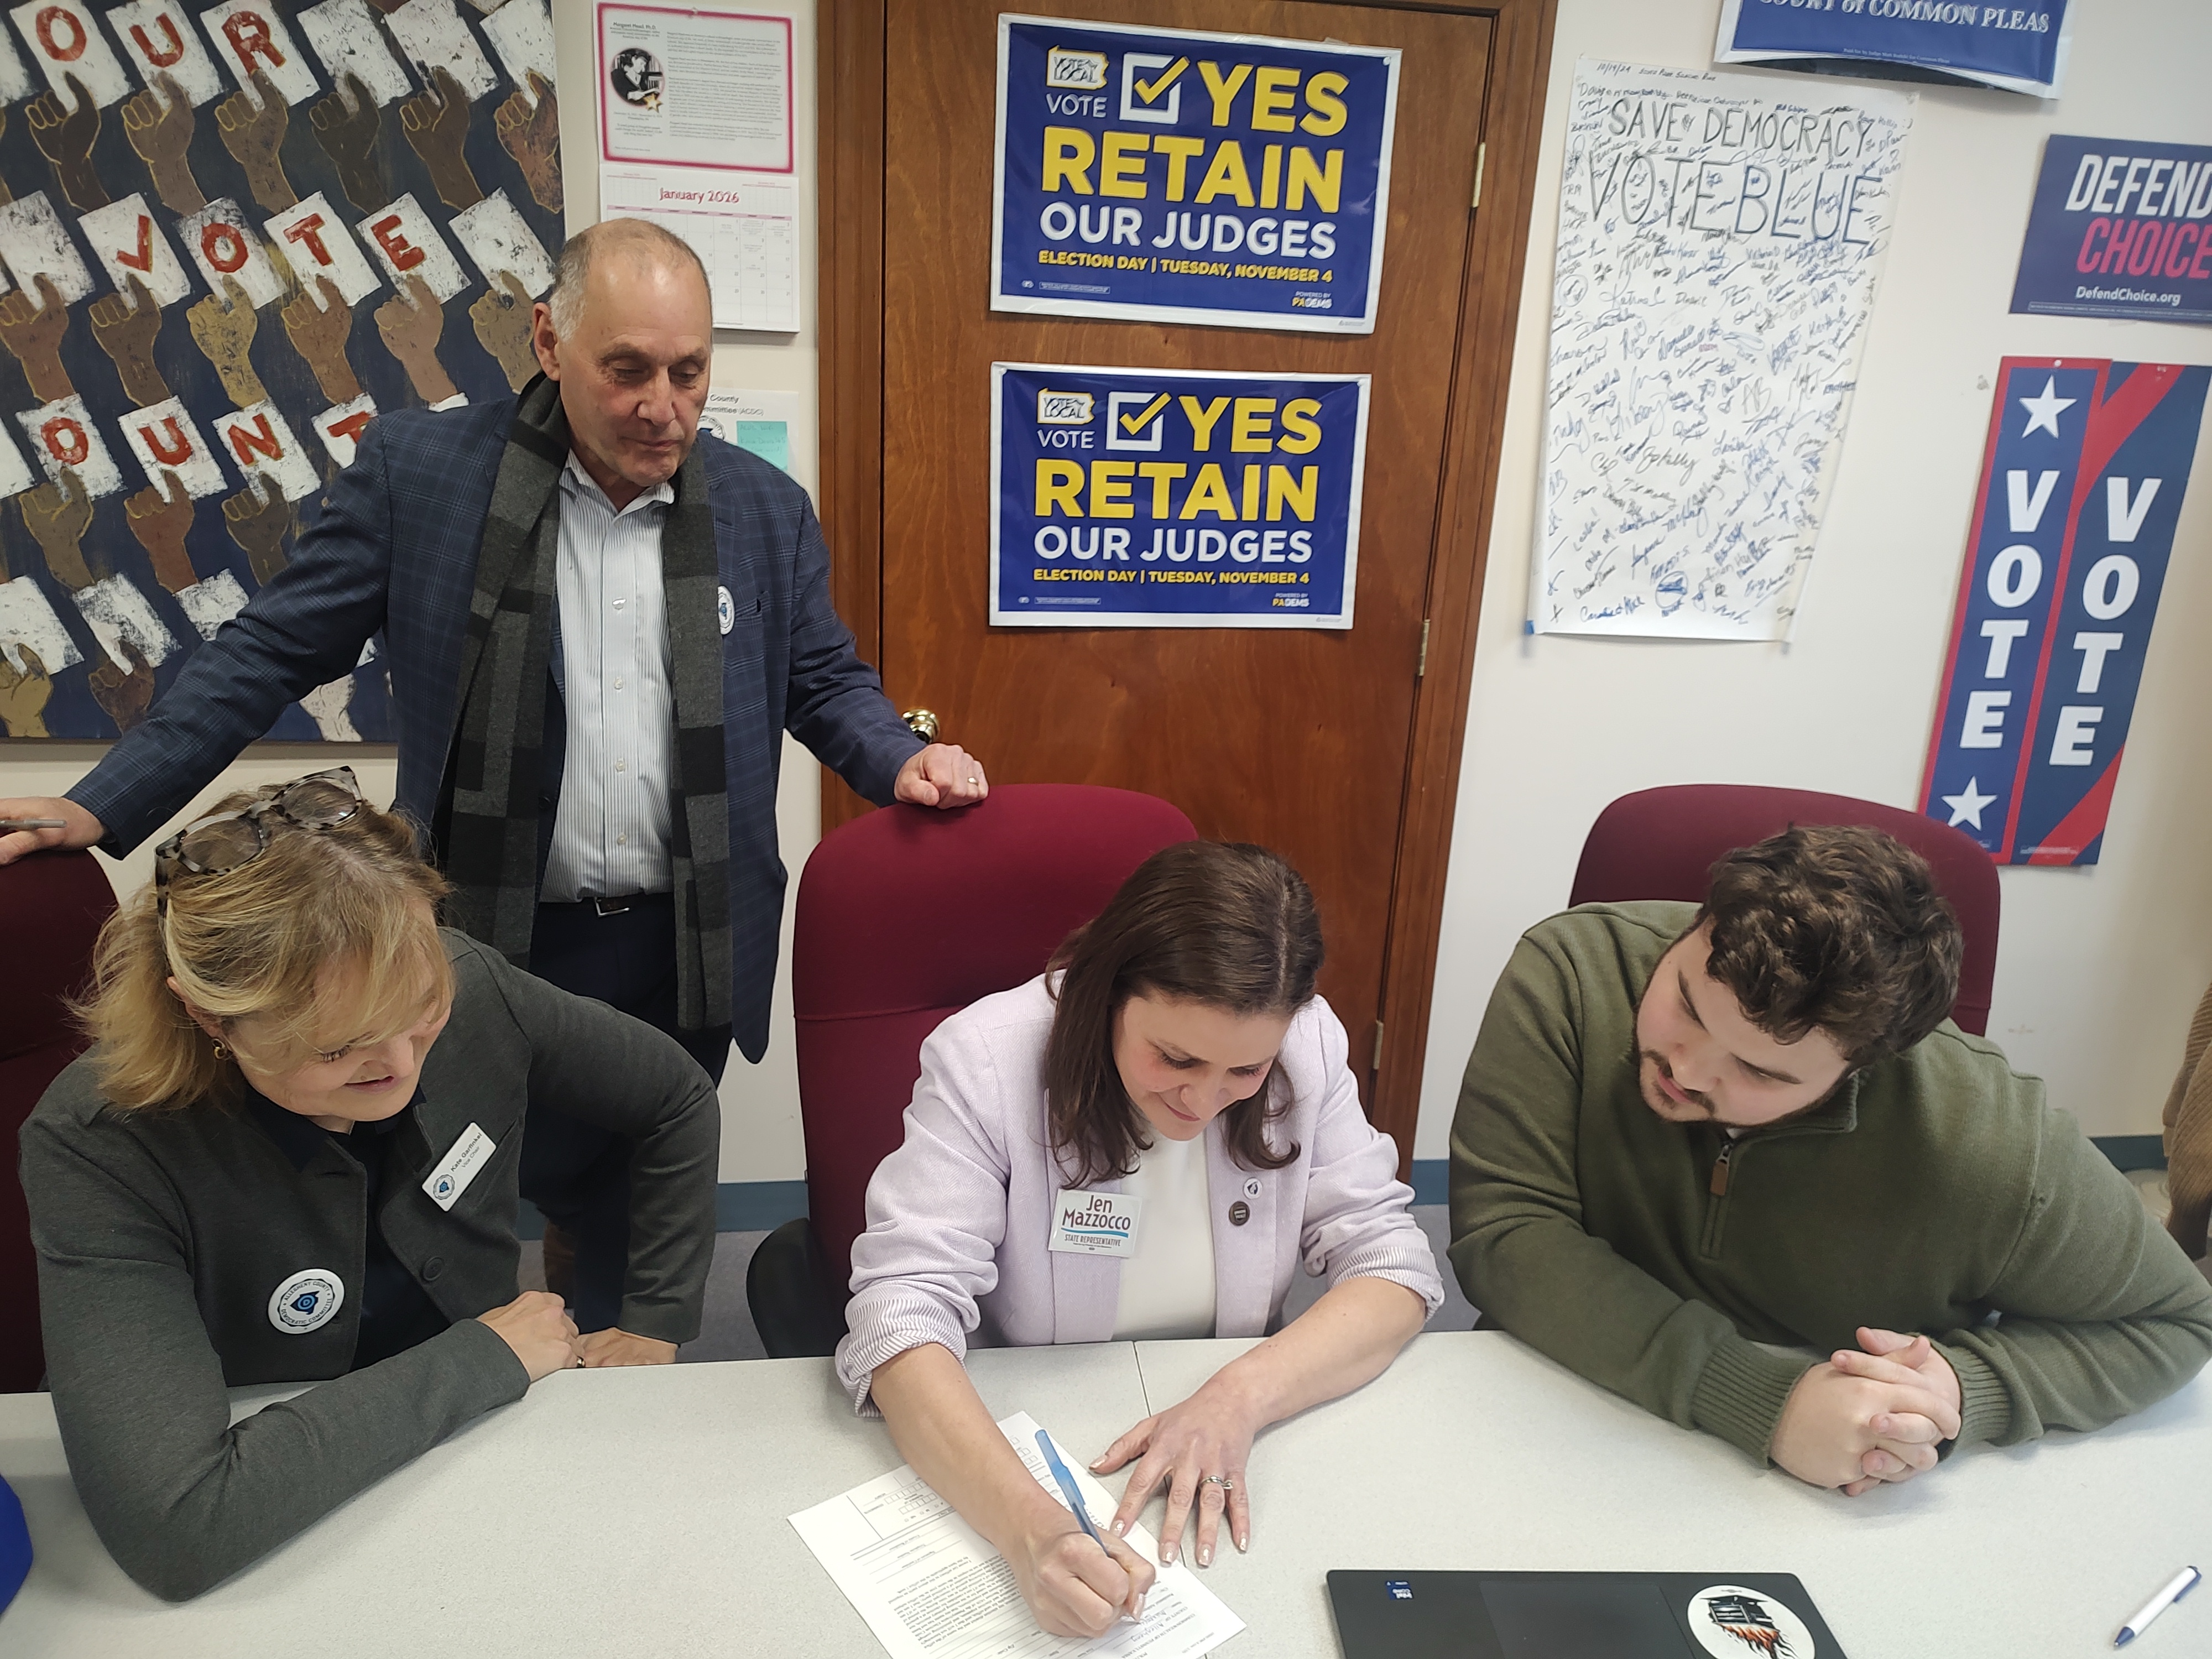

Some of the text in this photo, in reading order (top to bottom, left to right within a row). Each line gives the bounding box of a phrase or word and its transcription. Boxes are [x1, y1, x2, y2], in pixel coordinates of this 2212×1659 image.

[35, 6, 286, 79] OUR
[1869, 1, 1976, 26] COMMON
[1981, 8, 2051, 33] PLEAS
[1046, 60, 1349, 136] VOTE YES
[1609, 98, 1875, 158] SAVE DEMOCRACY
[660, 187, 740, 204] January 2026
[1042, 126, 1344, 213] RETAIN
[1589, 150, 1882, 245] VOTE BLUE
[2065, 154, 2212, 219] DEFEND
[117, 213, 426, 274] VOTE
[1040, 201, 1336, 259] OUR JUDGES
[2076, 217, 2212, 279] CHOICE
[1039, 250, 1333, 283] ELECTION DAY TUESDAY, NOVEMBER 4
[2075, 286, 2181, 306] DefendChoice.org
[1037, 395, 1322, 454] VOTE YES
[1035, 459, 1318, 521] RETAIN
[1034, 526, 1312, 563] OUR JUDGES
[1034, 569, 1310, 585] ELECTION DAY TUESDAY, NOVEMBER 4
[1960, 470, 2059, 748] VOTE
[2049, 477, 2162, 765] VOTE
[450, 1132, 482, 1172] Kate Garfinkel
[461, 1158, 471, 1167] Vice
[1062, 1207, 1131, 1230] Mazzocco
[1086, 1195, 1112, 1213] Jen
[1065, 1234, 1079, 1242] STATE
[1080, 1235, 1121, 1246] REPRESENTATIVE
[312, 1281, 330, 1292] COUNTY
